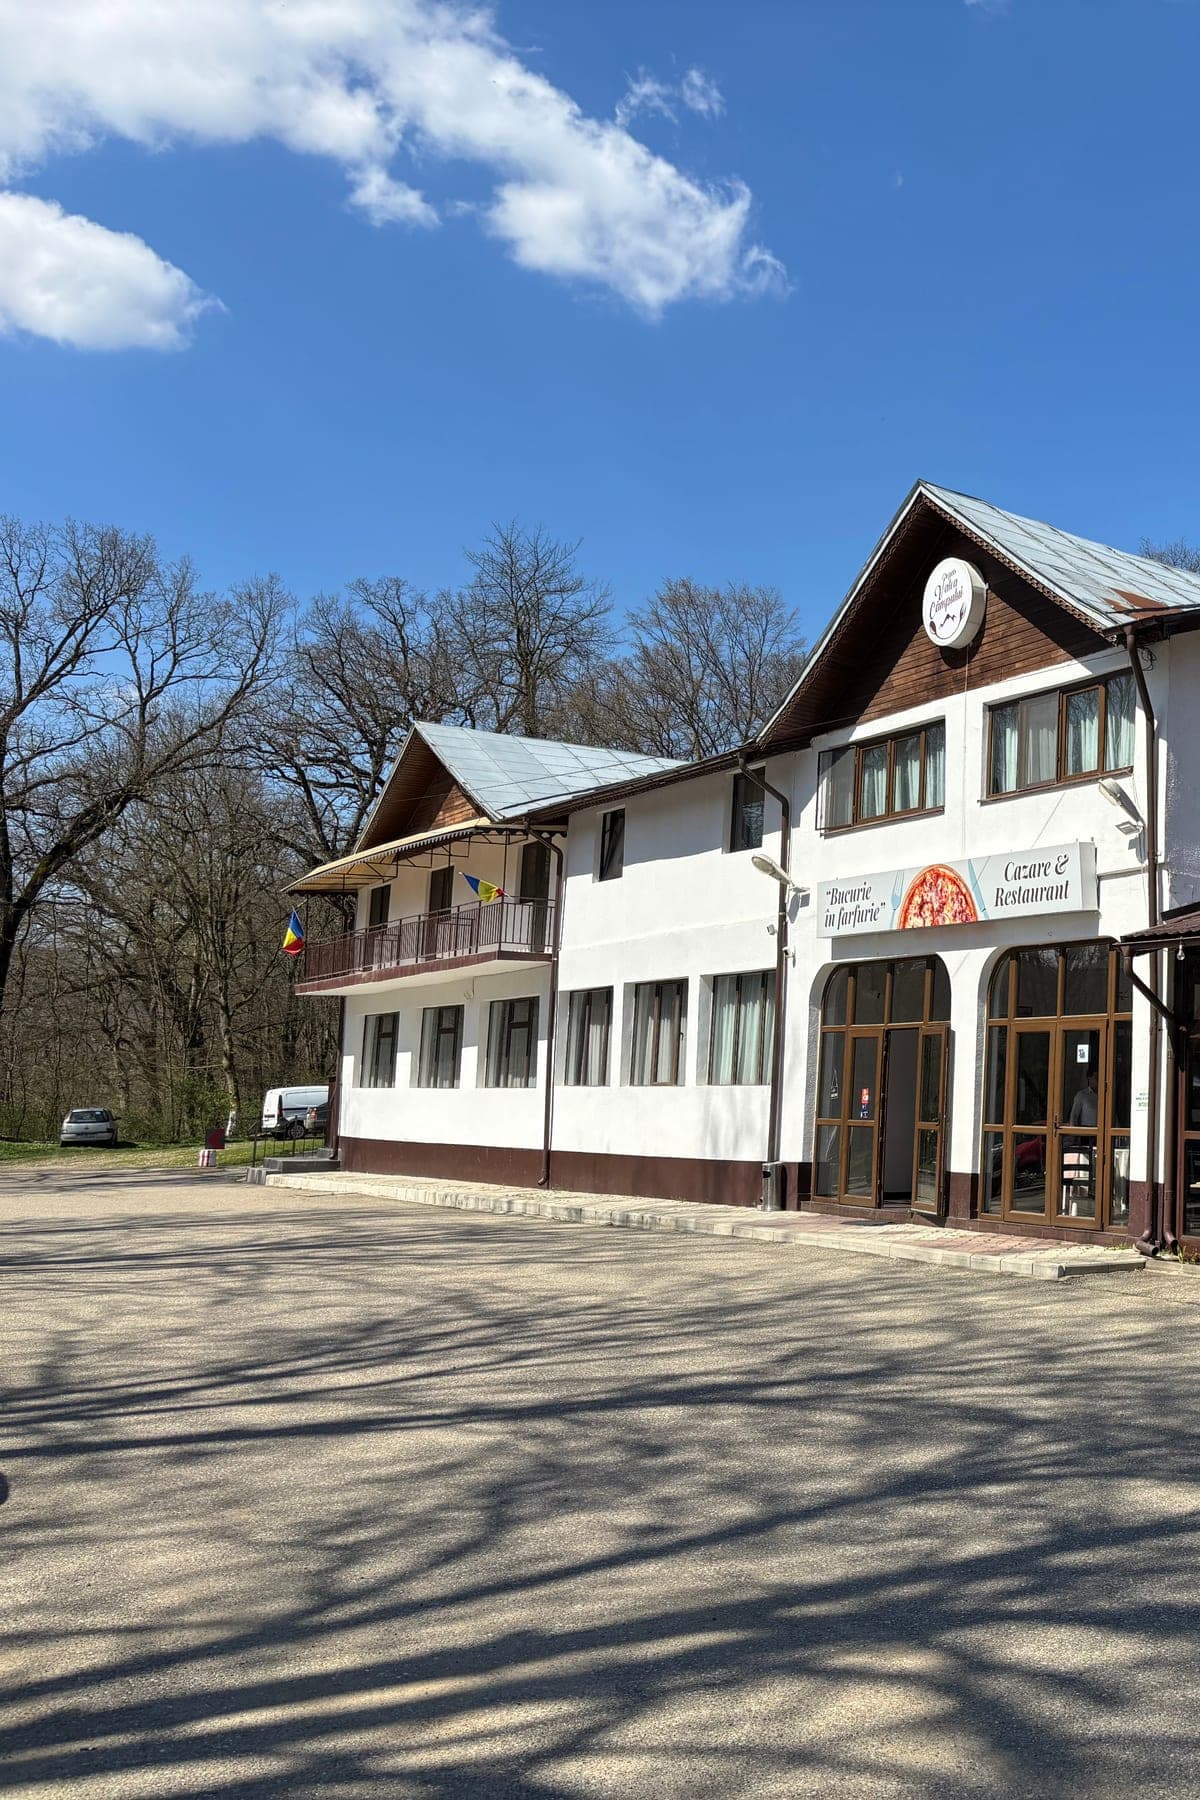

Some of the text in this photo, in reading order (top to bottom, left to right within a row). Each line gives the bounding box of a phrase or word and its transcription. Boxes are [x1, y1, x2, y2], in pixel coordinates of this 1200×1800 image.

[1004, 854, 1070, 883] Cazare &
[994, 879, 1070, 908] Restaurant
[824, 909, 835, 929] în
